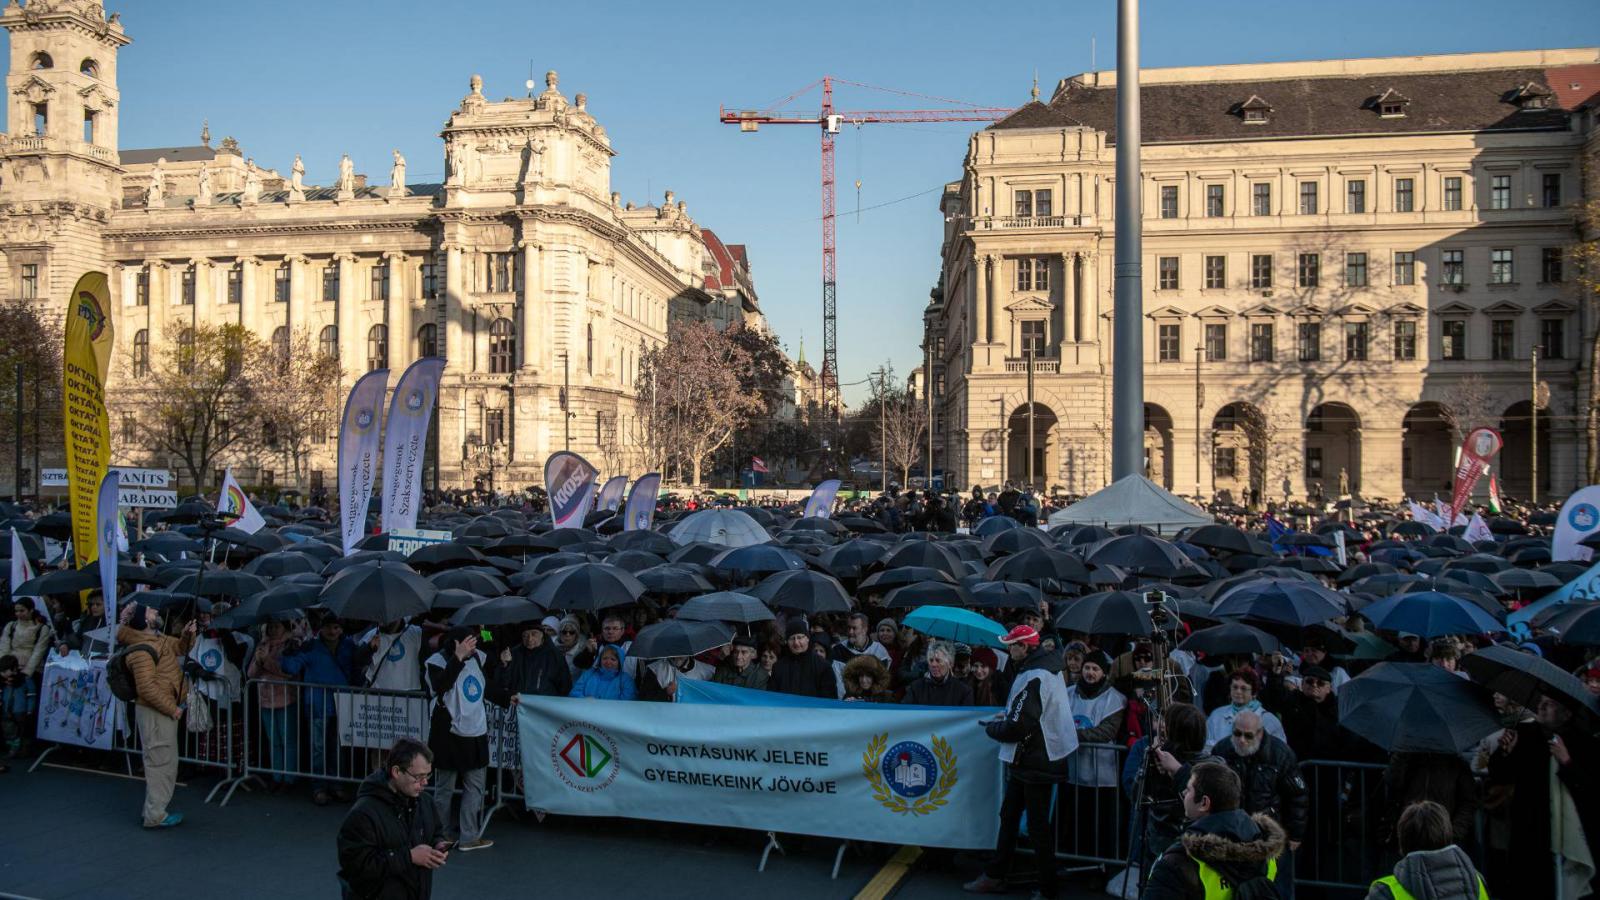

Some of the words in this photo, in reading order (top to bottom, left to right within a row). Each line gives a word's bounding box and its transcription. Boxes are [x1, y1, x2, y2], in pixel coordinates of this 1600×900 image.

[69, 406, 99, 423] OKTAT
[119, 470, 164, 485] ANÍTS
[399, 435, 419, 516] Szakszervezete
[119, 493, 177, 505] ABADON
[646, 743, 758, 762] OKTATÁSUNK
[763, 750, 829, 766] JELENE
[644, 768, 763, 791] GYERMEKEINK
[768, 776, 837, 794] JÖVŐJE
